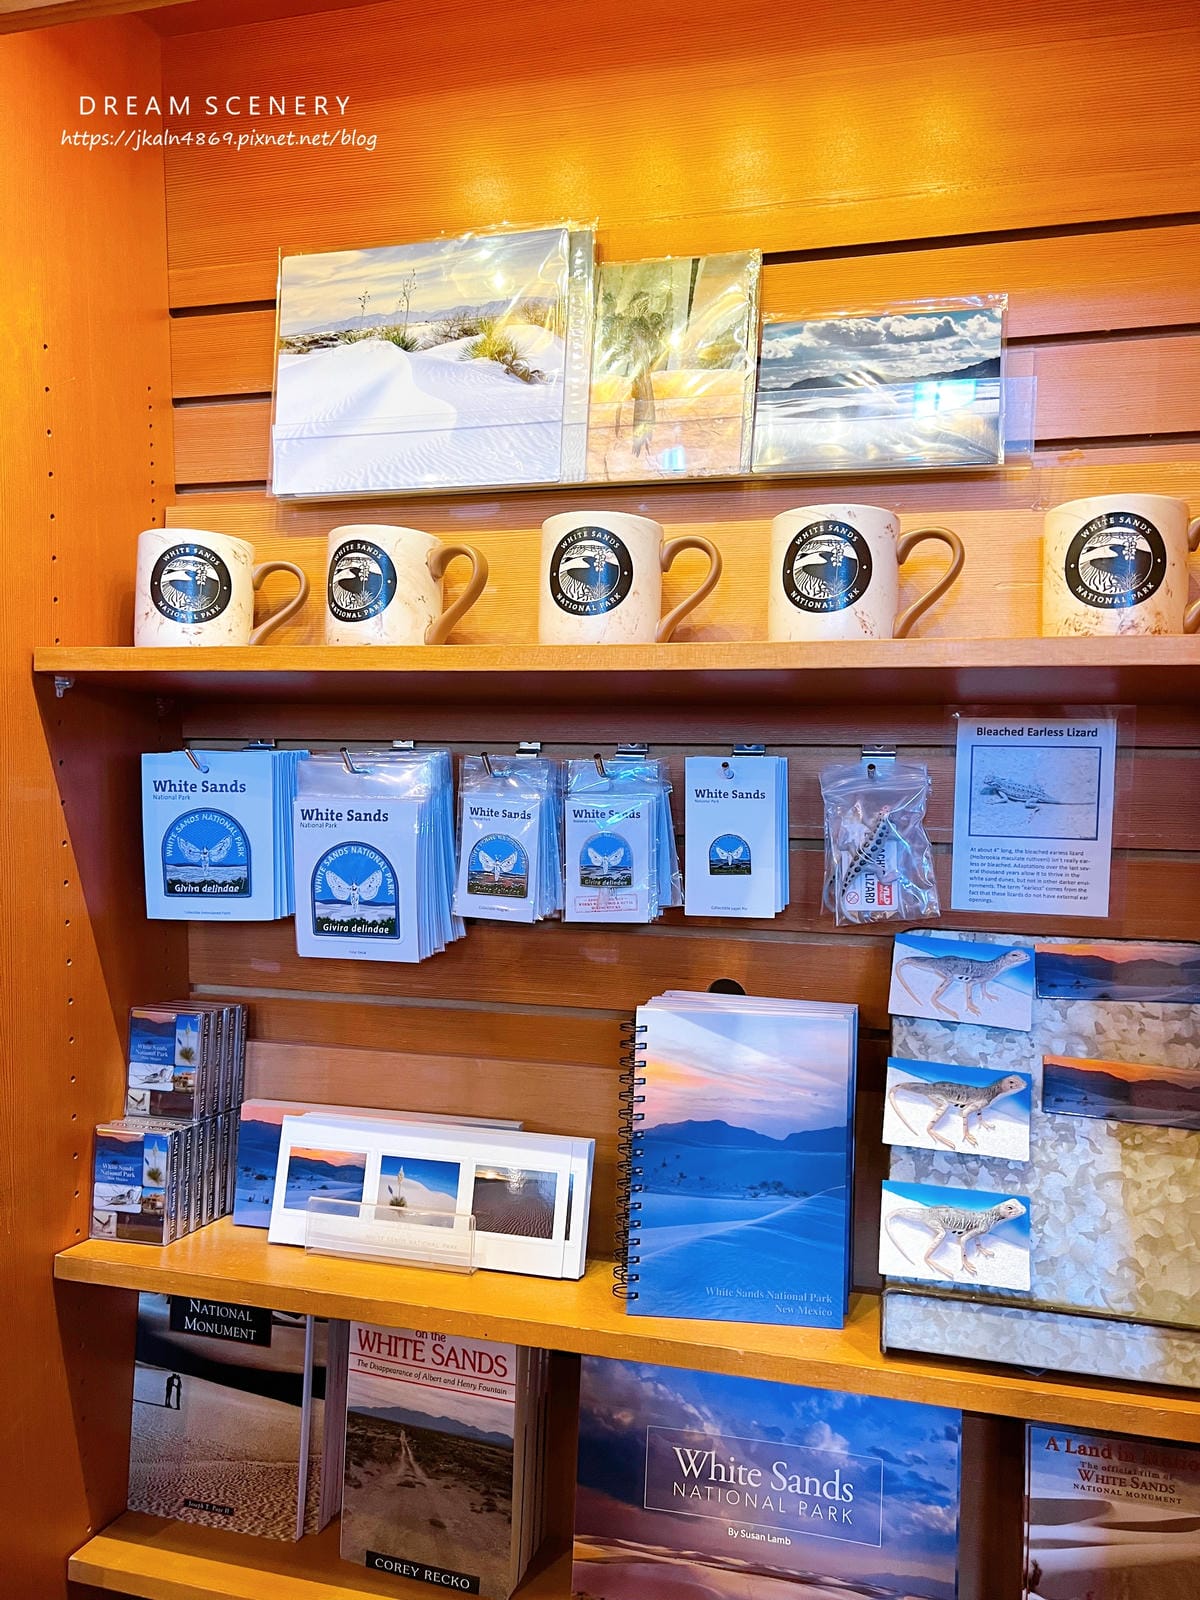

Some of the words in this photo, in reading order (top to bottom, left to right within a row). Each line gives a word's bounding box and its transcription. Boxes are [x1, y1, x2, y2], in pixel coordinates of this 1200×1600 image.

[795, 525, 824, 545] WHITE
[828, 524, 858, 542] SANDS
[1081, 516, 1114, 538] WHITE
[1119, 516, 1152, 535] SANDS
[561, 531, 588, 549] WHITE
[591, 531, 620, 549] SANDS
[163, 547, 190, 561] WHITE
[194, 548, 220, 566] SANDS
[335, 544, 353, 561] WHITE
[357, 544, 385, 559] SANDS
[556, 593, 596, 611] NATIONAL
[790, 590, 834, 608] NATIONAL
[1075, 585, 1126, 604] NATIONAL
[1131, 582, 1154, 600] PARK
[201, 605, 220, 618] PARK
[331, 602, 362, 618] NATIONAL
[364, 601, 384, 615] PARK
[977, 727, 1024, 736] Bleached
[1028, 728, 1063, 737] Earless
[1067, 728, 1098, 737] Lizard
[153, 780, 197, 792] White
[201, 780, 246, 793] Sands
[695, 789, 728, 799] White
[732, 790, 766, 799] Sands
[300, 808, 343, 821] White
[347, 809, 389, 822] Sands
[470, 807, 499, 817] White
[502, 809, 531, 820] Sands
[573, 810, 605, 819] White
[166, 832, 177, 857] WHITE
[176, 815, 200, 833] SANDS
[202, 814, 237, 836] NATIONAL
[235, 836, 244, 857] PARK
[315, 866, 326, 893] WHITE
[325, 848, 348, 866] SANDS
[351, 846, 387, 872] NATIONAL
[385, 873, 394, 895] PARK
[174, 884, 199, 892] Givira
[202, 884, 239, 893] delindae
[865, 873, 875, 904] LIZARD
[323, 924, 348, 932] Givira
[352, 924, 389, 933] delindae
[705, 1287, 733, 1297] White
[736, 1289, 764, 1299] Sands
[767, 1291, 807, 1302] National
[810, 1293, 832, 1304] Park
[190, 1299, 253, 1322] NATIONAL
[776, 1304, 794, 1314] New
[799, 1306, 833, 1317] Mexico
[184, 1317, 256, 1340] MONUMENT
[416, 1329, 428, 1339] on
[431, 1331, 446, 1343] the
[358, 1328, 425, 1362] WHITE
[431, 1344, 507, 1378] SANDS
[357, 1359, 368, 1367] The
[369, 1361, 413, 1378] Disappearance
[414, 1371, 422, 1380] of
[422, 1373, 442, 1383] Albert
[443, 1376, 455, 1385] and
[457, 1379, 477, 1391] Henry
[478, 1383, 507, 1395] Fountain
[1045, 1437, 1060, 1451] A
[1065, 1439, 1112, 1459] Land
[673, 1447, 761, 1487] White
[771, 1461, 853, 1503] Sands
[1080, 1461, 1098, 1470] The
[1102, 1465, 1137, 1476] official
[1139, 1469, 1159, 1479] film
[1078, 1468, 1127, 1487] WHITE
[1130, 1477, 1175, 1494] SANDS
[1073, 1483, 1122, 1496] NATIONAL
[1126, 1491, 1182, 1504] MONUMENT
[673, 1481, 786, 1514] NATIONAL
[800, 1500, 853, 1525] PARK
[728, 1527, 739, 1538] By
[741, 1529, 765, 1541] Susan
[767, 1533, 791, 1546] Lamb
[375, 1558, 420, 1577] COREY
[425, 1569, 470, 1589] RECKO
